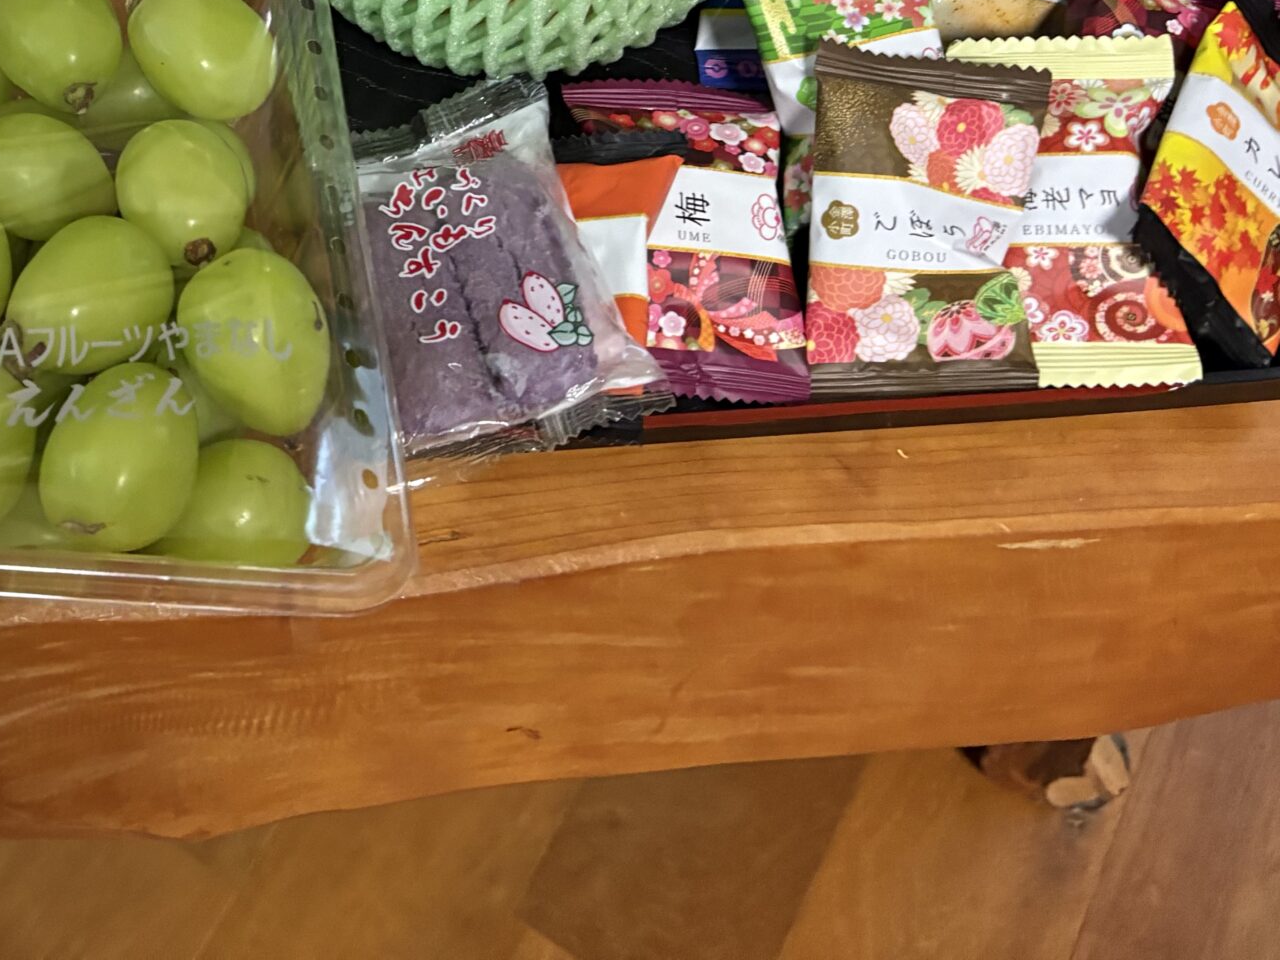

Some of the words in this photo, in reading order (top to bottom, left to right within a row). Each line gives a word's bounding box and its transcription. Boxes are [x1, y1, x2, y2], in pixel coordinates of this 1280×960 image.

[674, 192, 711, 227] 梅
[873, 209, 967, 239] ごぼう
[677, 229, 712, 243] UME
[1022, 224, 1105, 236] EBIMAYO
[378, 183, 462, 343] ちんすこう
[886, 248, 947, 263] GOBOU
[7, 371, 197, 427] えんざん
